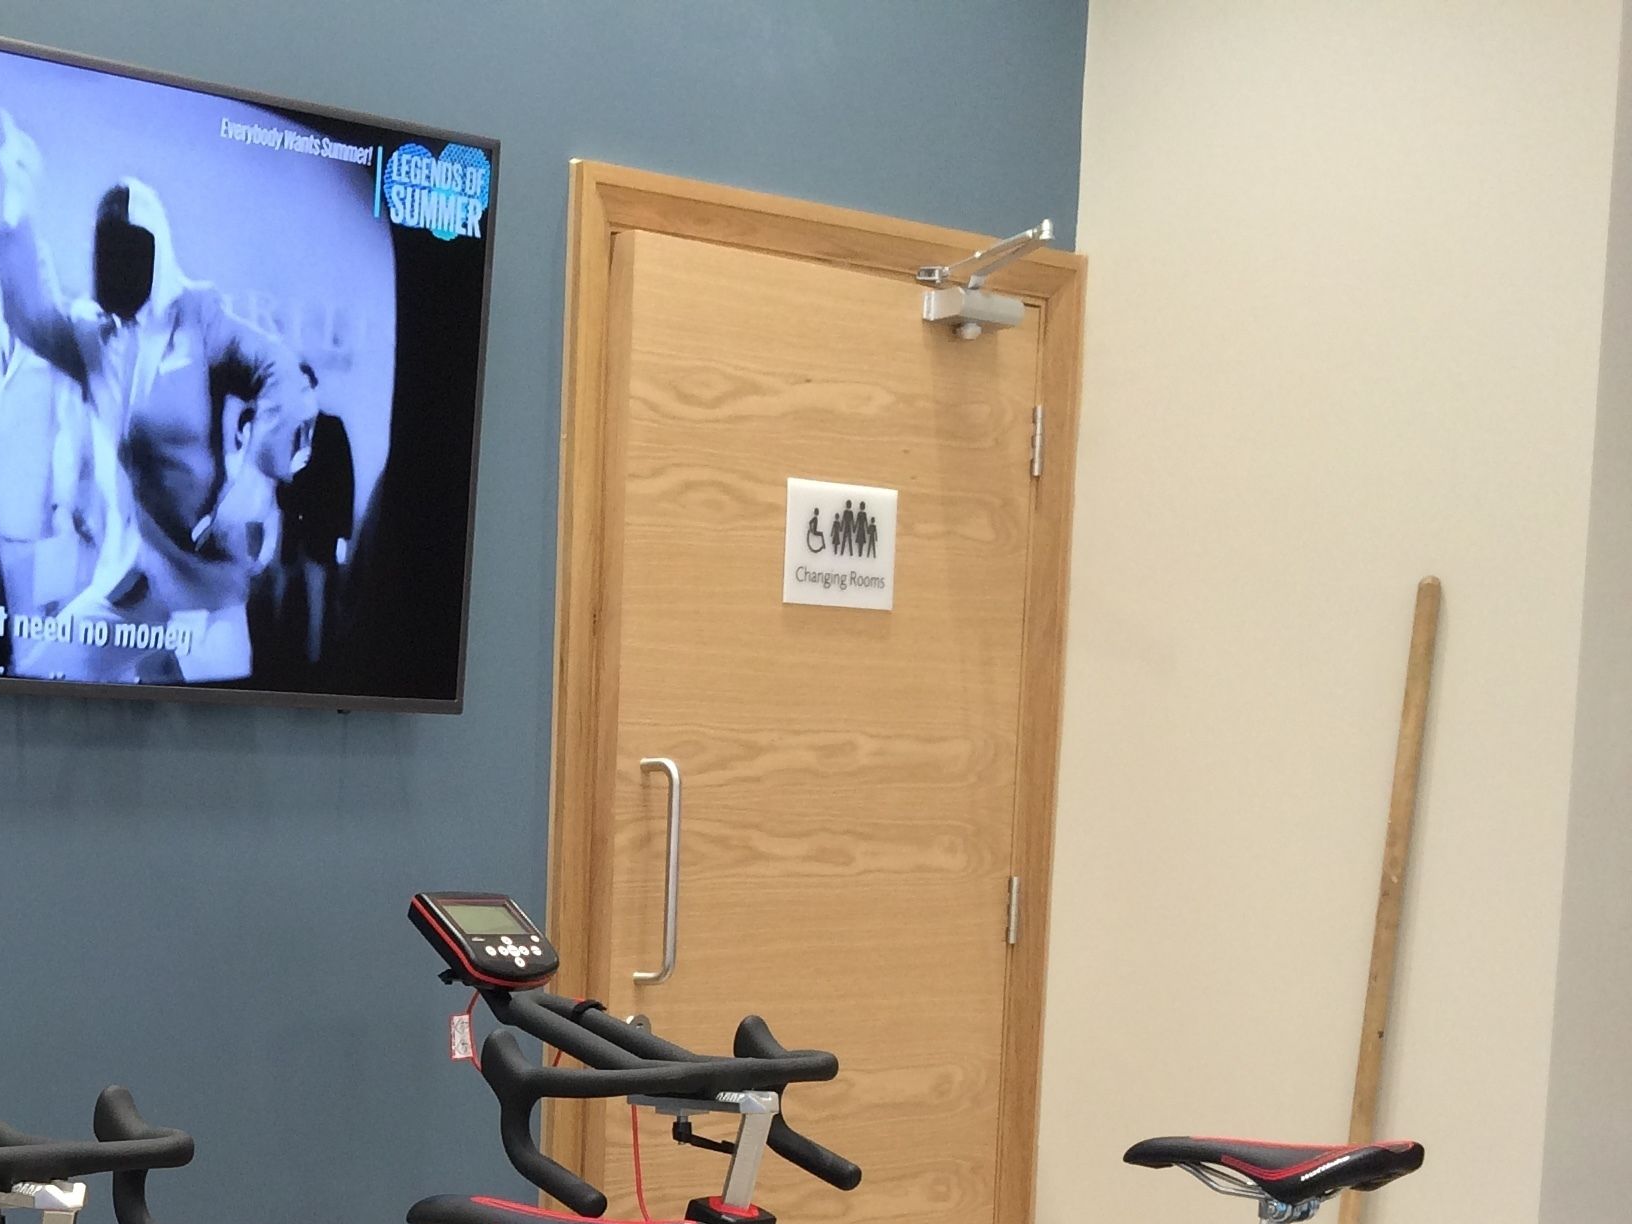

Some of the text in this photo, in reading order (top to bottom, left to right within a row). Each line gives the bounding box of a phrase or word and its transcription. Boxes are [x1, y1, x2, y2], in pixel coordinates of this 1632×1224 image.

[220, 117, 373, 166] Everybody Wants Summer!
[392, 151, 485, 197] LEGENDS OF
[390, 185, 482, 238] SUMMER
[795, 566, 886, 590] Changing Rooms
[13, 613, 73, 644] need
[79, 618, 109, 647] no
[114, 622, 192, 655] money
